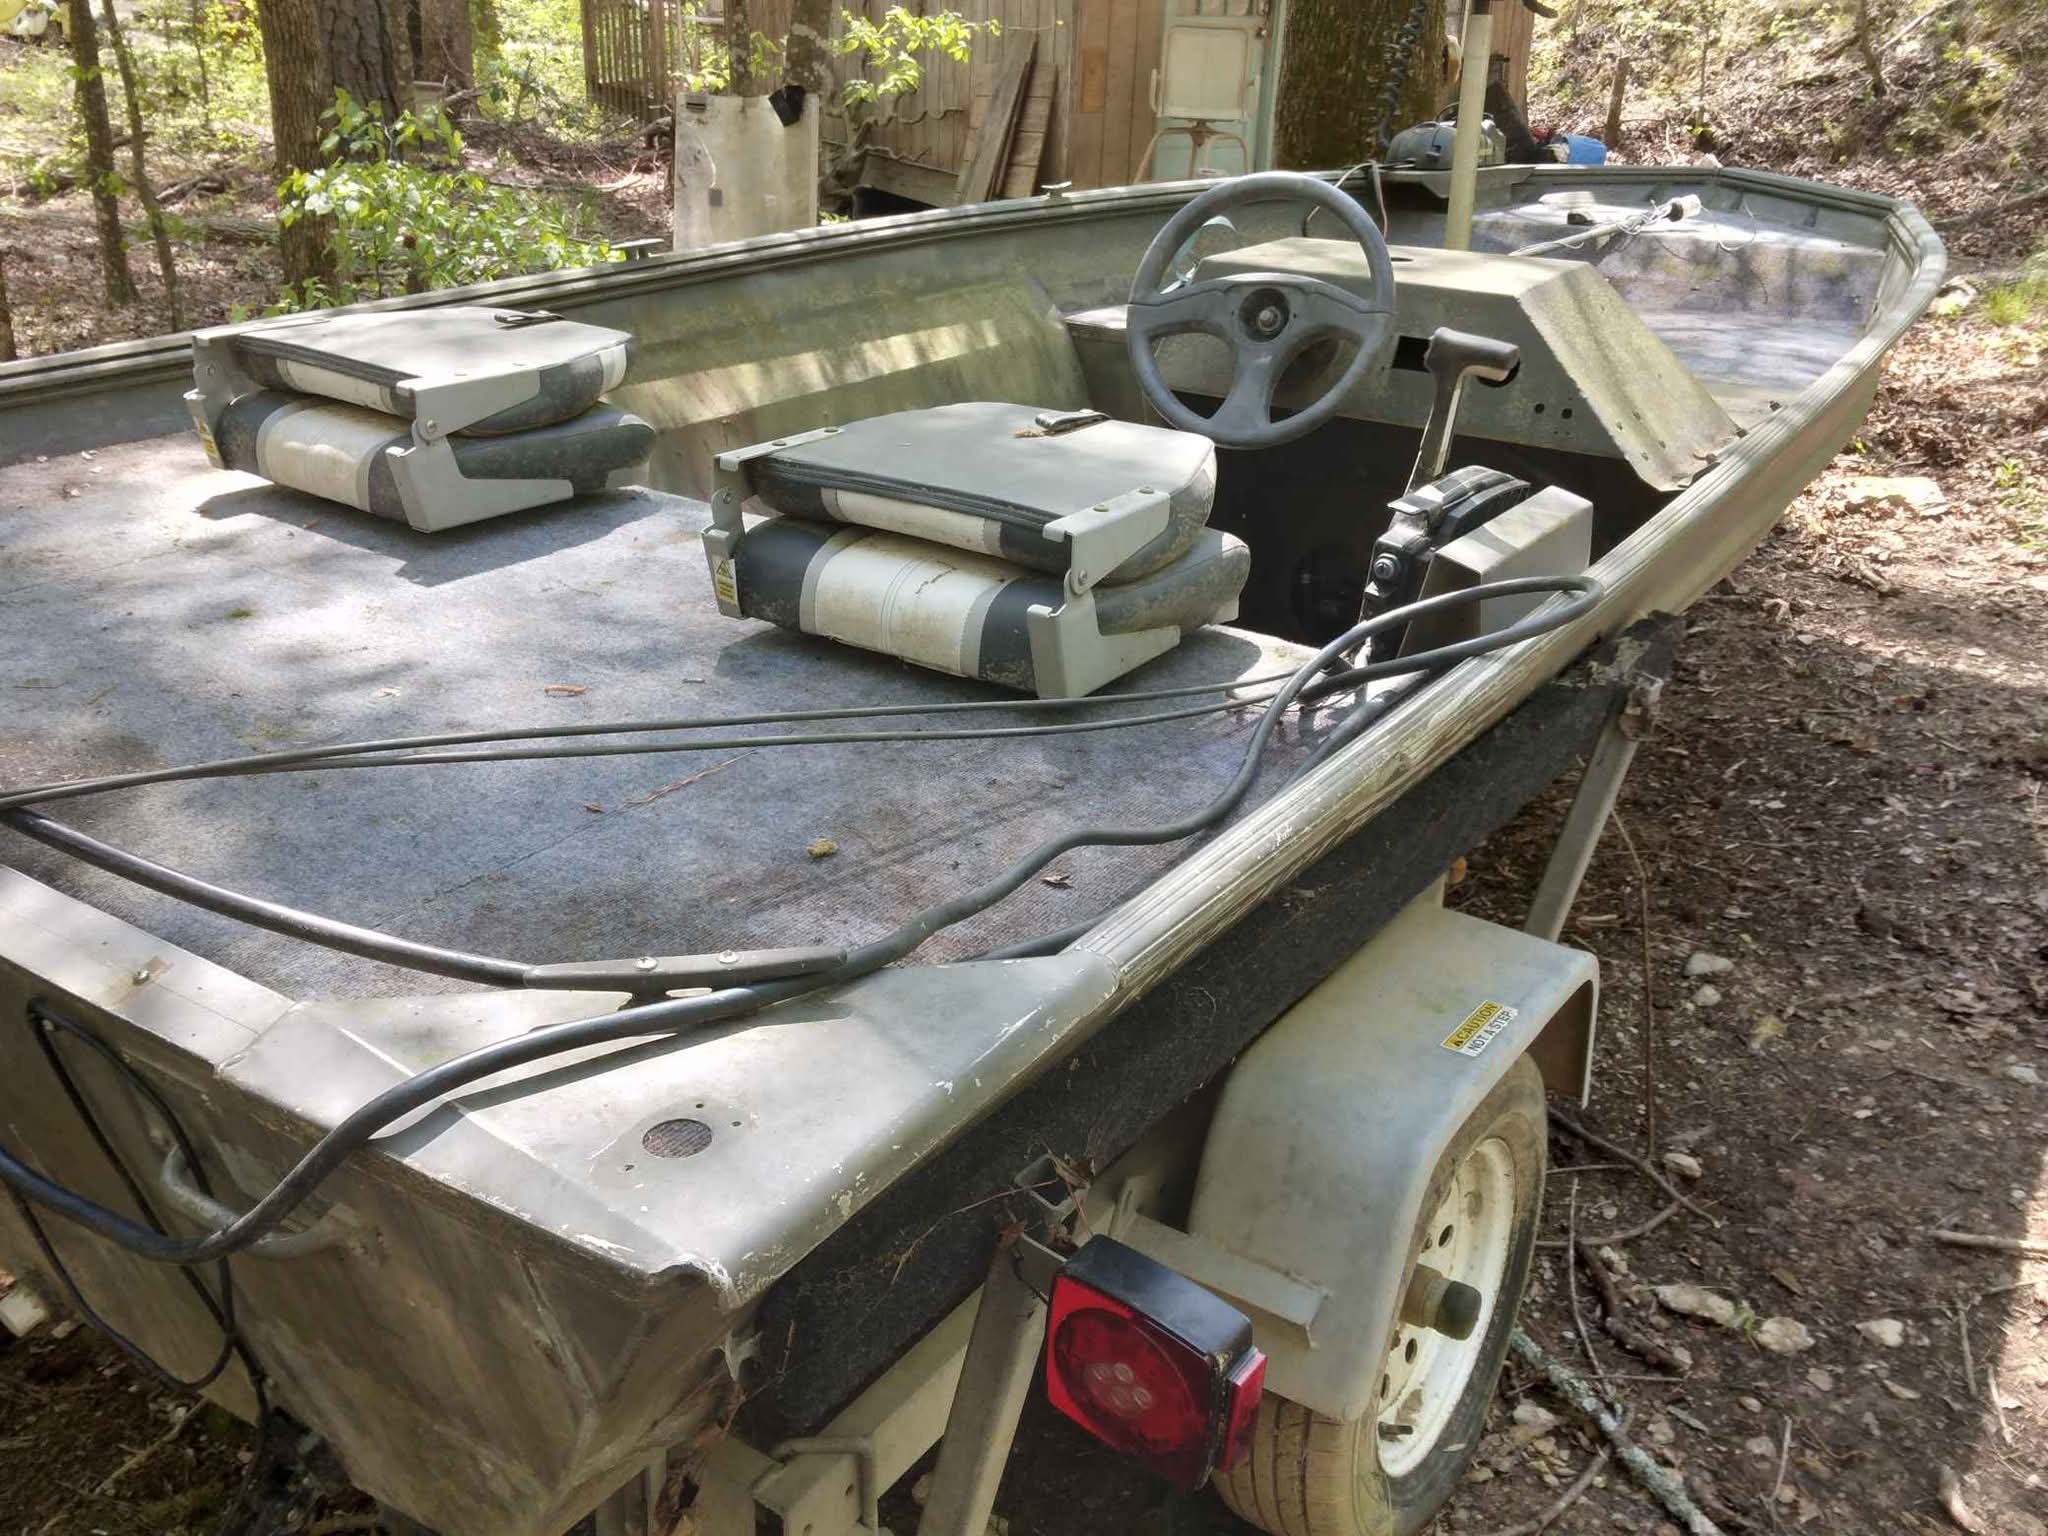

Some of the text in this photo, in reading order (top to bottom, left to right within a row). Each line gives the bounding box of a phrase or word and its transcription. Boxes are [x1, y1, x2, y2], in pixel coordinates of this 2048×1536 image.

[1457, 1003, 1498, 1039] CAUTION
[1467, 1034, 1486, 1052] NOT
[1488, 1010, 1512, 1029] STEP
